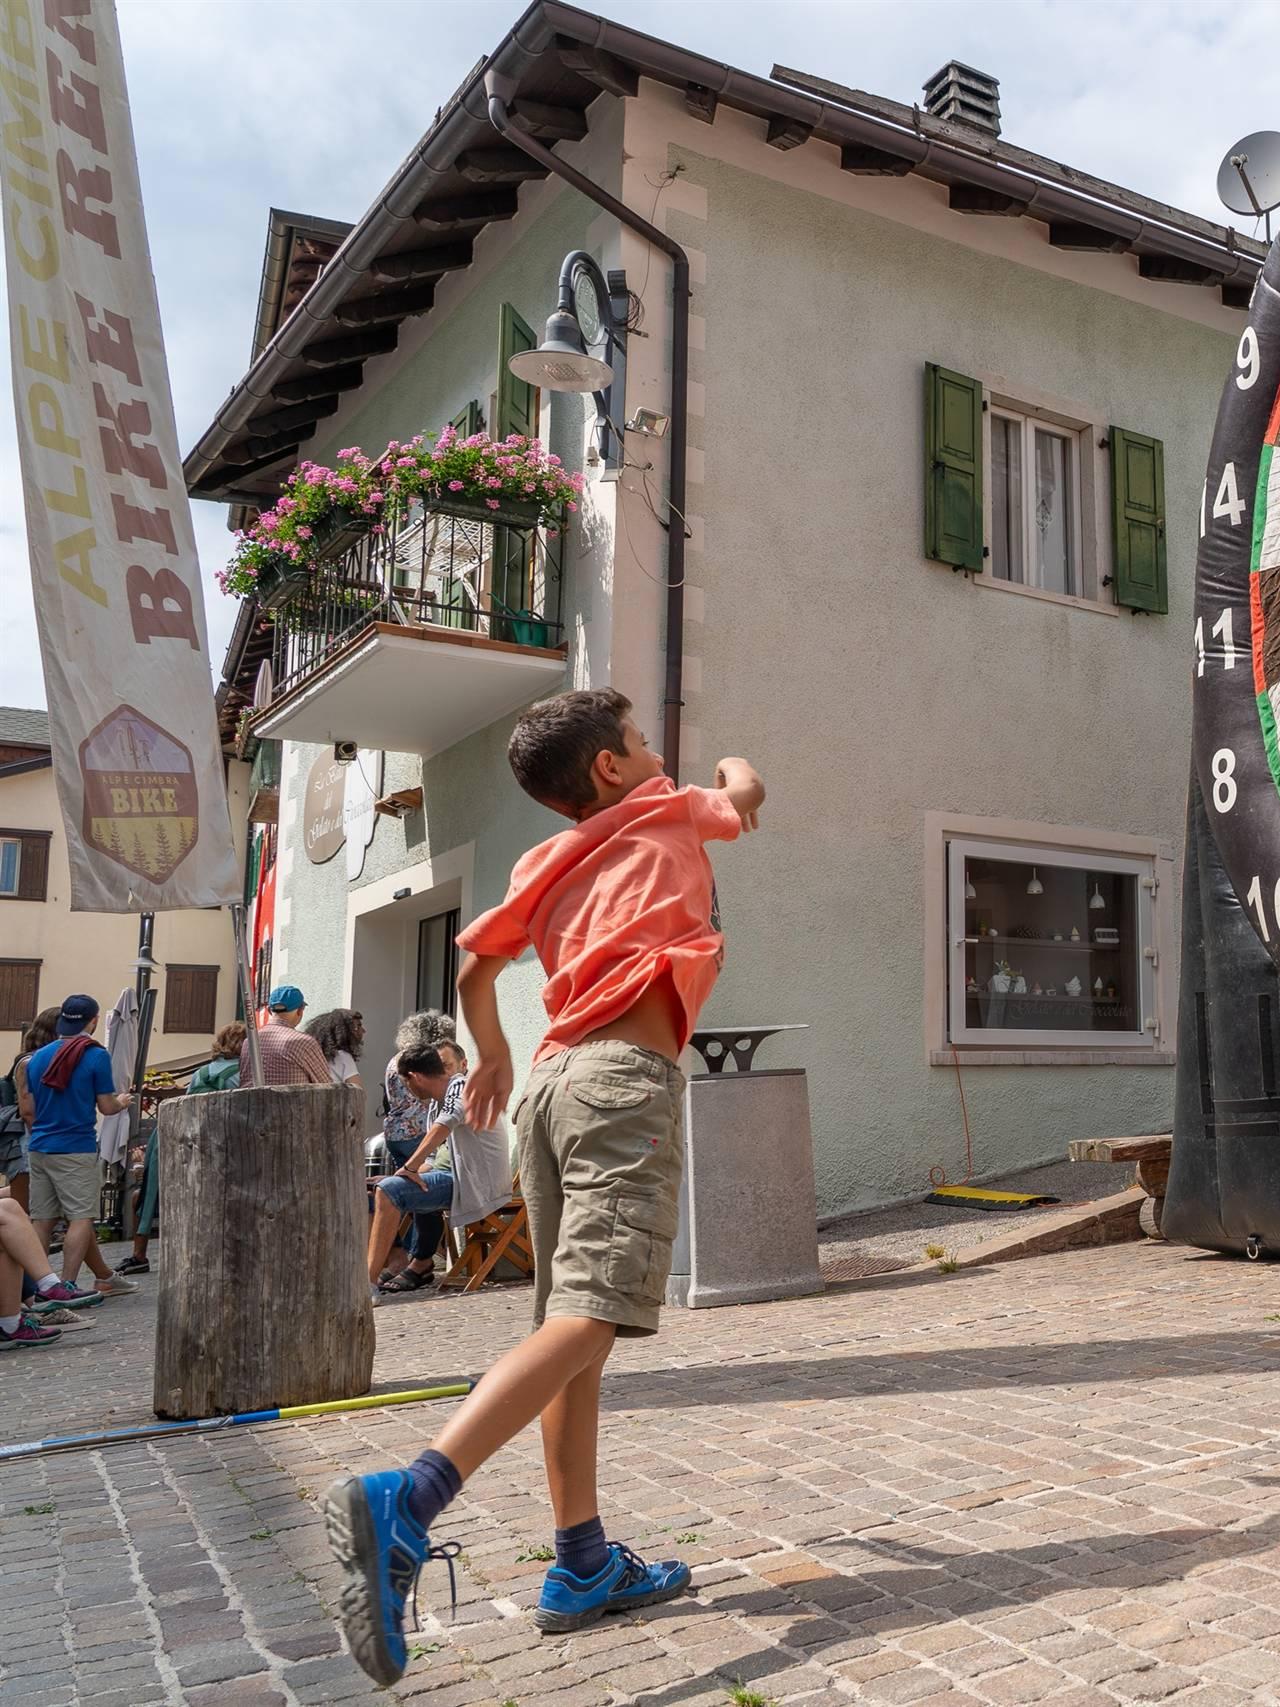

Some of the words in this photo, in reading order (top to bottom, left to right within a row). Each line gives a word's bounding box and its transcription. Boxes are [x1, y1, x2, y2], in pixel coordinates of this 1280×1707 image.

[1235, 326, 1260, 390] 9
[20, 303, 108, 609] ALPE
[74, 290, 201, 652] BIKE
[1200, 462, 1247, 538] 14
[1193, 607, 1236, 678] 11
[110, 787, 178, 814] BIKE
[1211, 747, 1238, 814] 8
